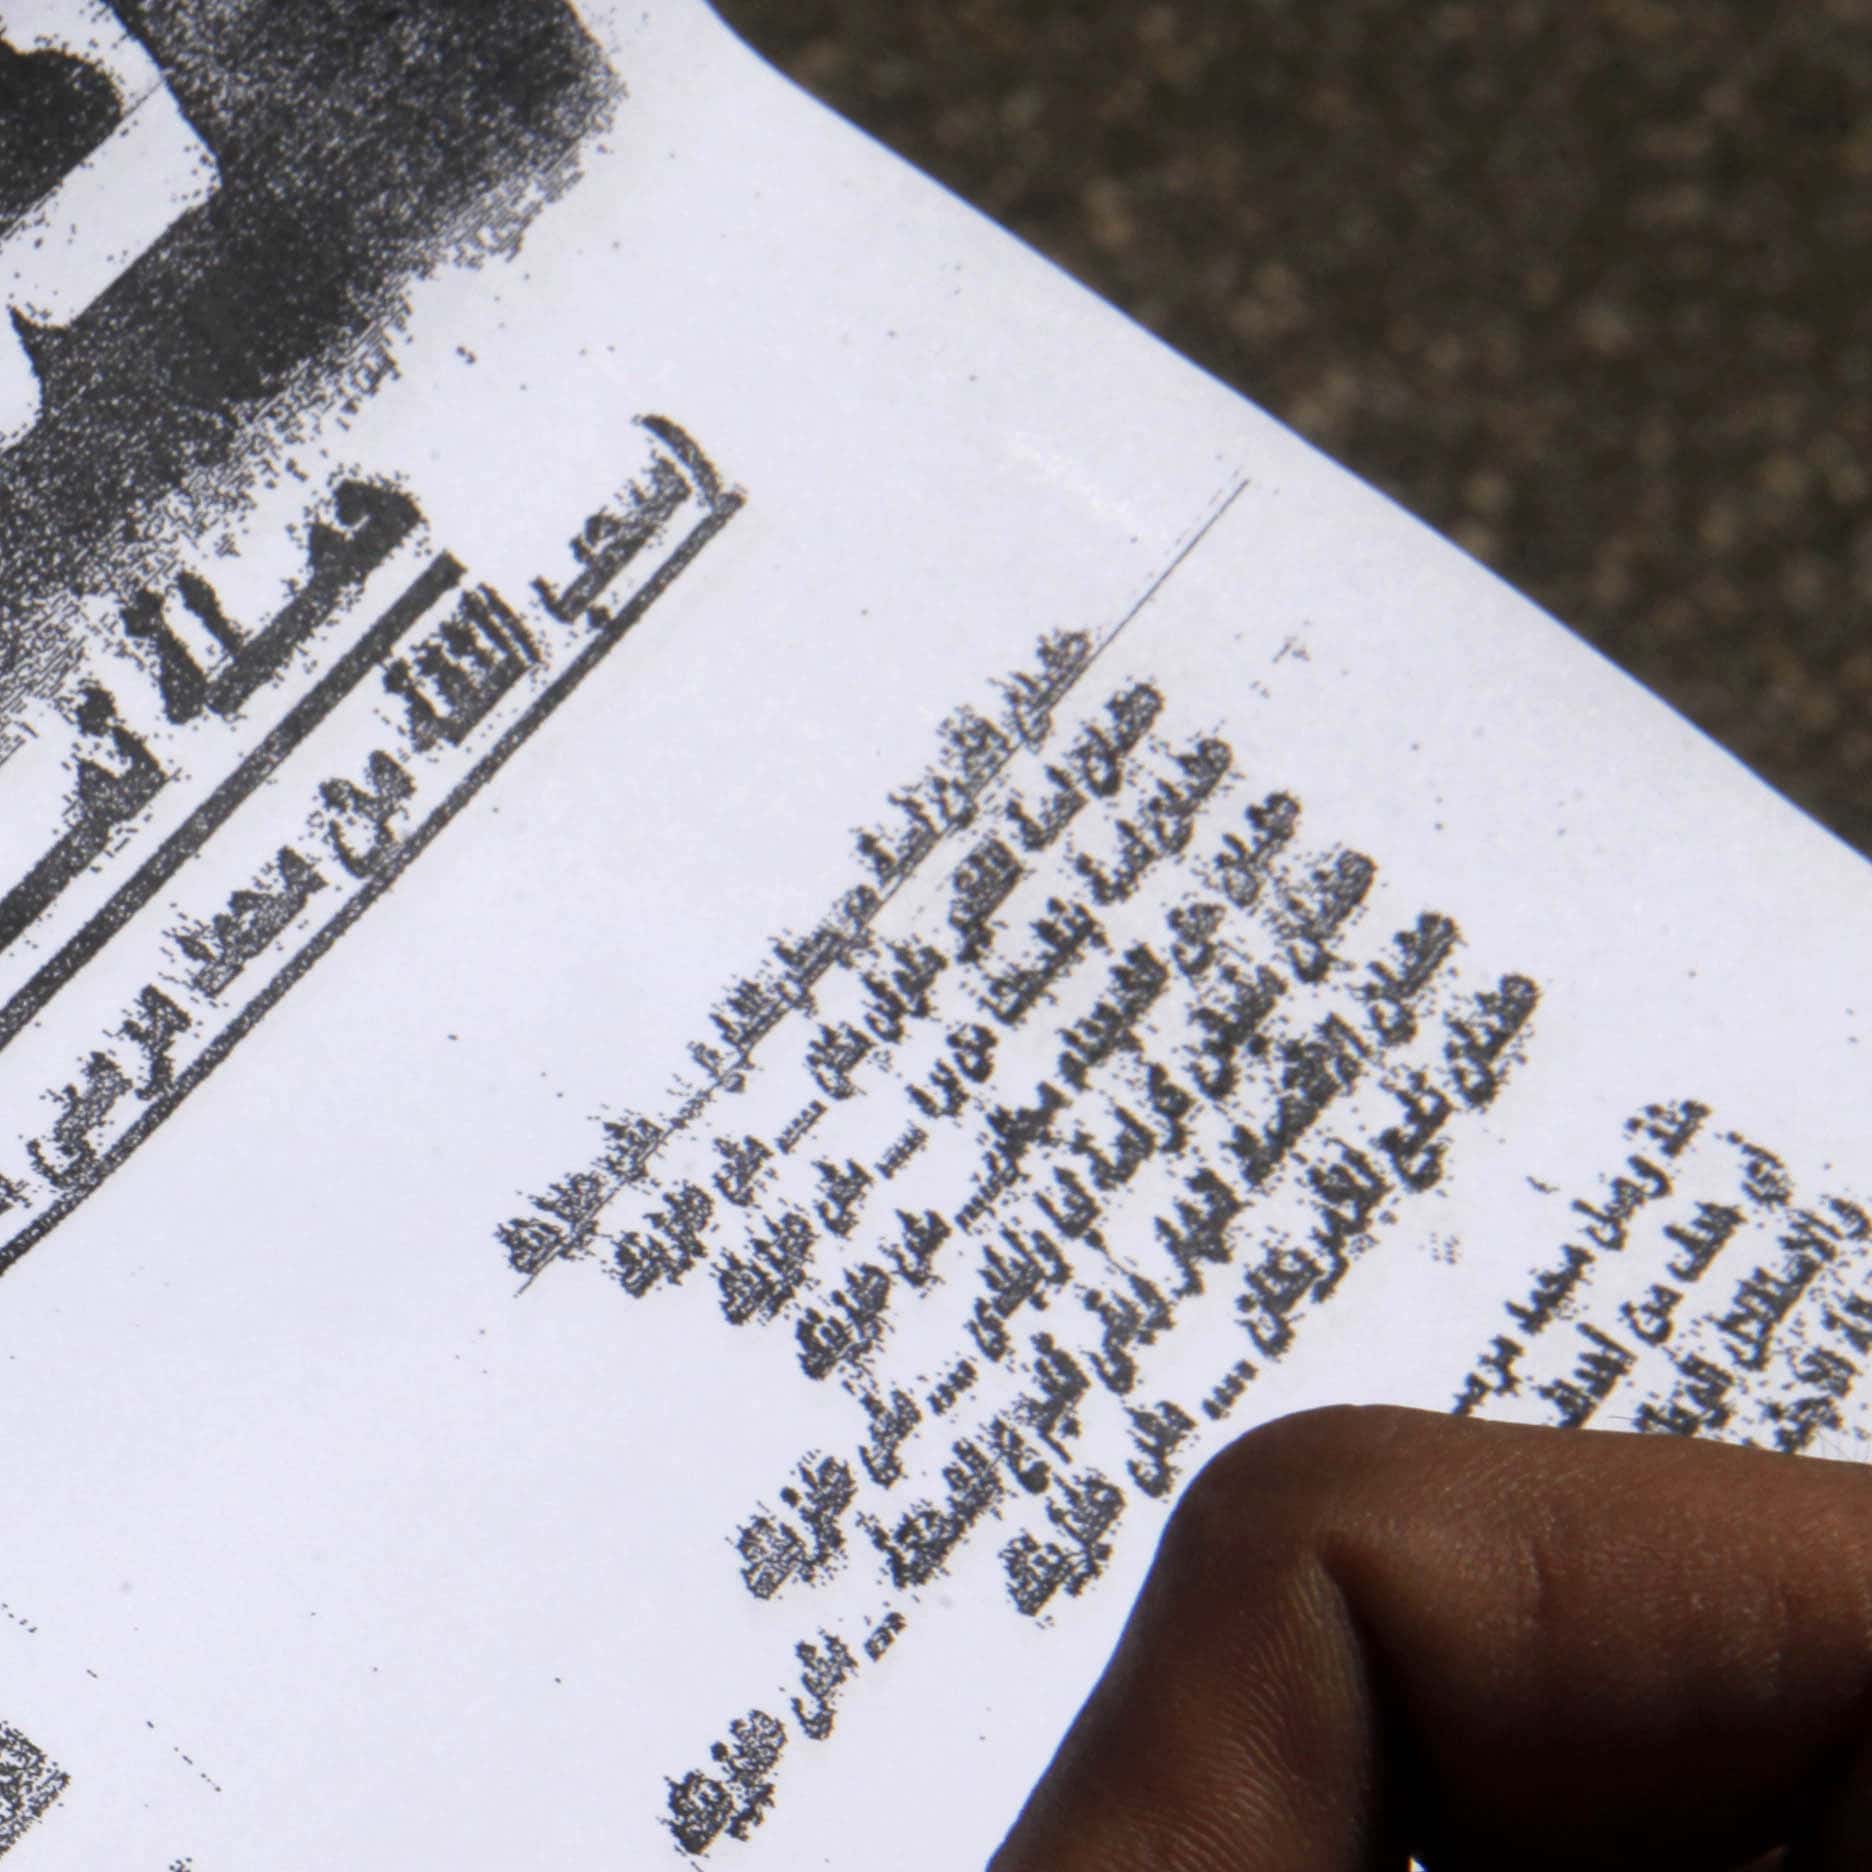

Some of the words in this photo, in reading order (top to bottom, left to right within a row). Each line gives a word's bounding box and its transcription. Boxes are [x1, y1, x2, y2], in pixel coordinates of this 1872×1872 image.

[1072, 685, 1161, 797] عشان
[1148, 740, 1230, 854] عشان
[321, 752, 442, 878] من
[1216, 794, 1299, 908] عشان
[175, 848, 325, 997] محمد
[1277, 852, 1375, 985] عشان
[1361, 915, 1457, 1046] عشان
[1445, 976, 1537, 1108] عشان
[714, 1137, 772, 1206] مش
[816, 1162, 871, 1237] مش
[884, 1211, 950, 1286] مش
[1507, 1246, 1593, 1334] محمد
[1622, 1286, 1681, 1346] من
[860, 1391, 920, 1489] مش
[1113, 1367, 1195, 1497] مش
